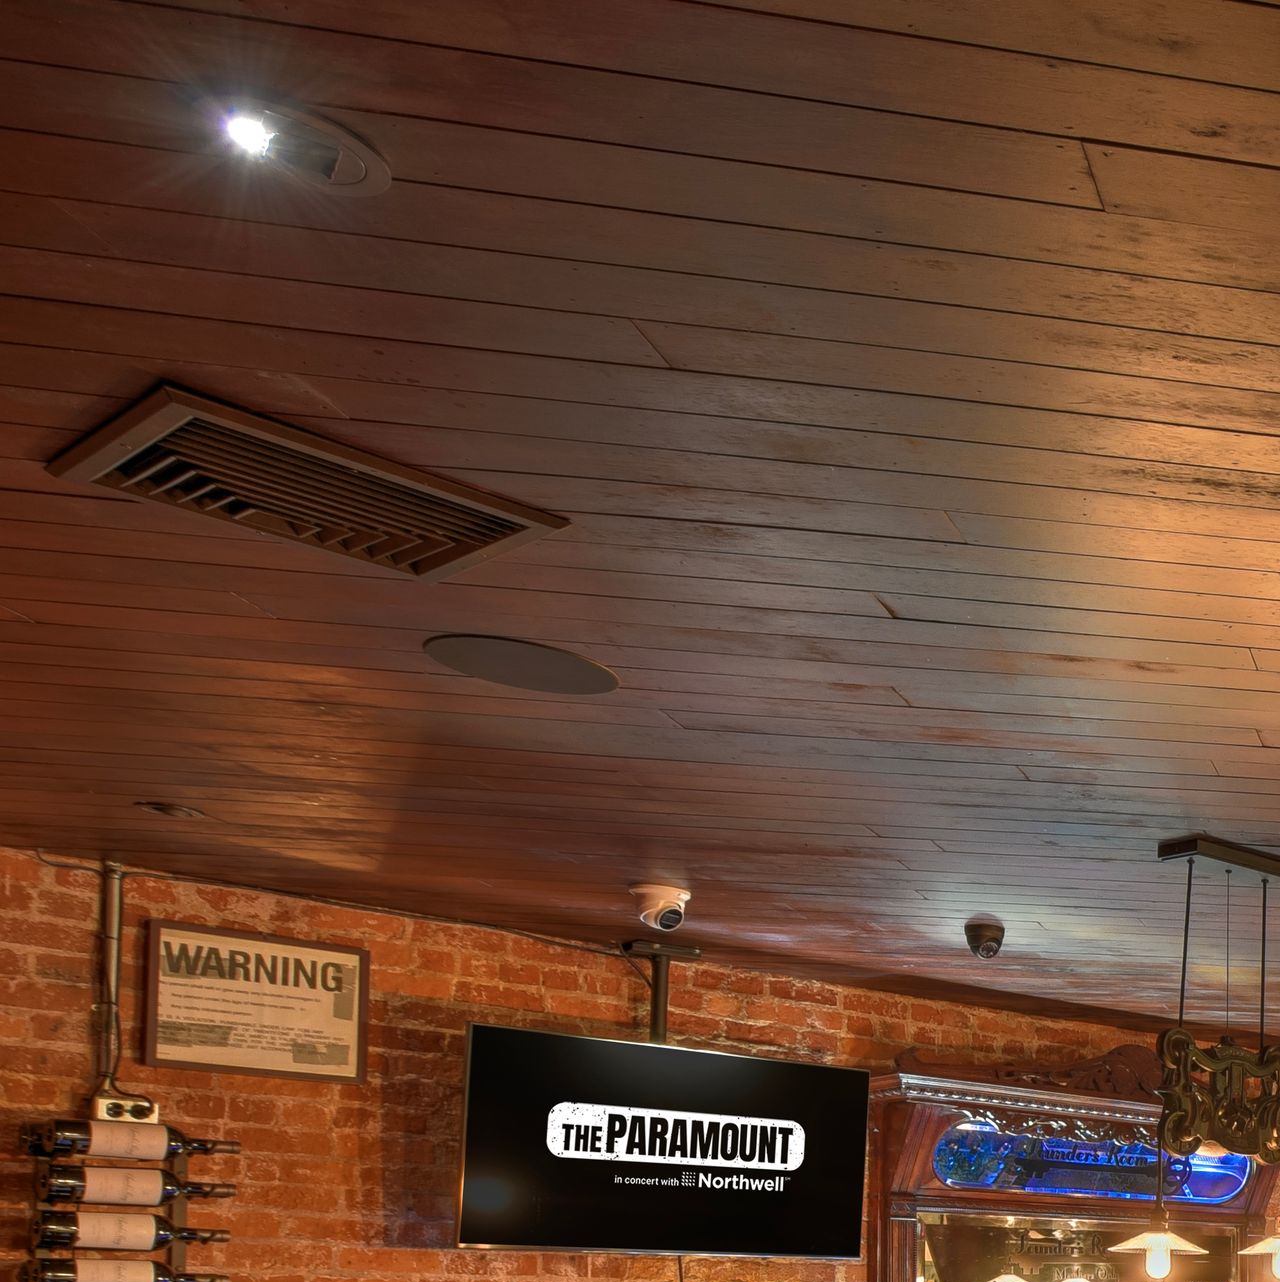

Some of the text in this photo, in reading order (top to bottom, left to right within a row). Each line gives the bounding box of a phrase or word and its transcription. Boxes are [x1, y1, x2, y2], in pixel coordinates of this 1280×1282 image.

[163, 941, 343, 993] WARNING
[562, 1113, 794, 1164] THE PARAMOUNT
[614, 1172, 784, 1192] in concert with Northwell
